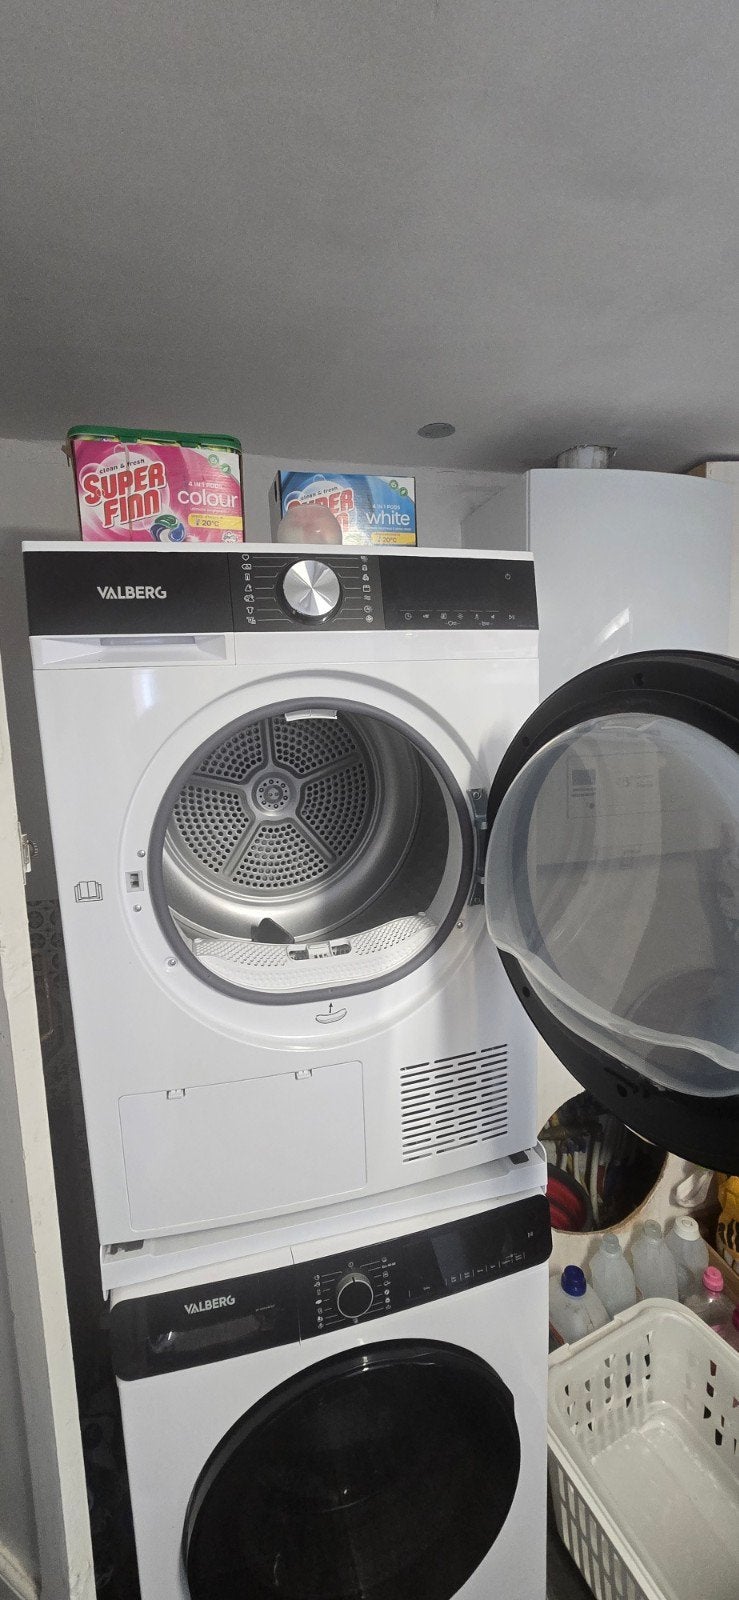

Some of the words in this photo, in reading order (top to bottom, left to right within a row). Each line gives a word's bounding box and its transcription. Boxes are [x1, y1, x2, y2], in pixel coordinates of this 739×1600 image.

[99, 465, 118, 474] clean
[127, 458, 145, 467] fresh
[83, 462, 166, 505] SUPER
[177, 489, 238, 508] colour
[104, 490, 161, 527] FINN
[365, 510, 411, 526] white
[96, 586, 167, 600] VALBERG
[184, 1295, 236, 1315] VALBERG
